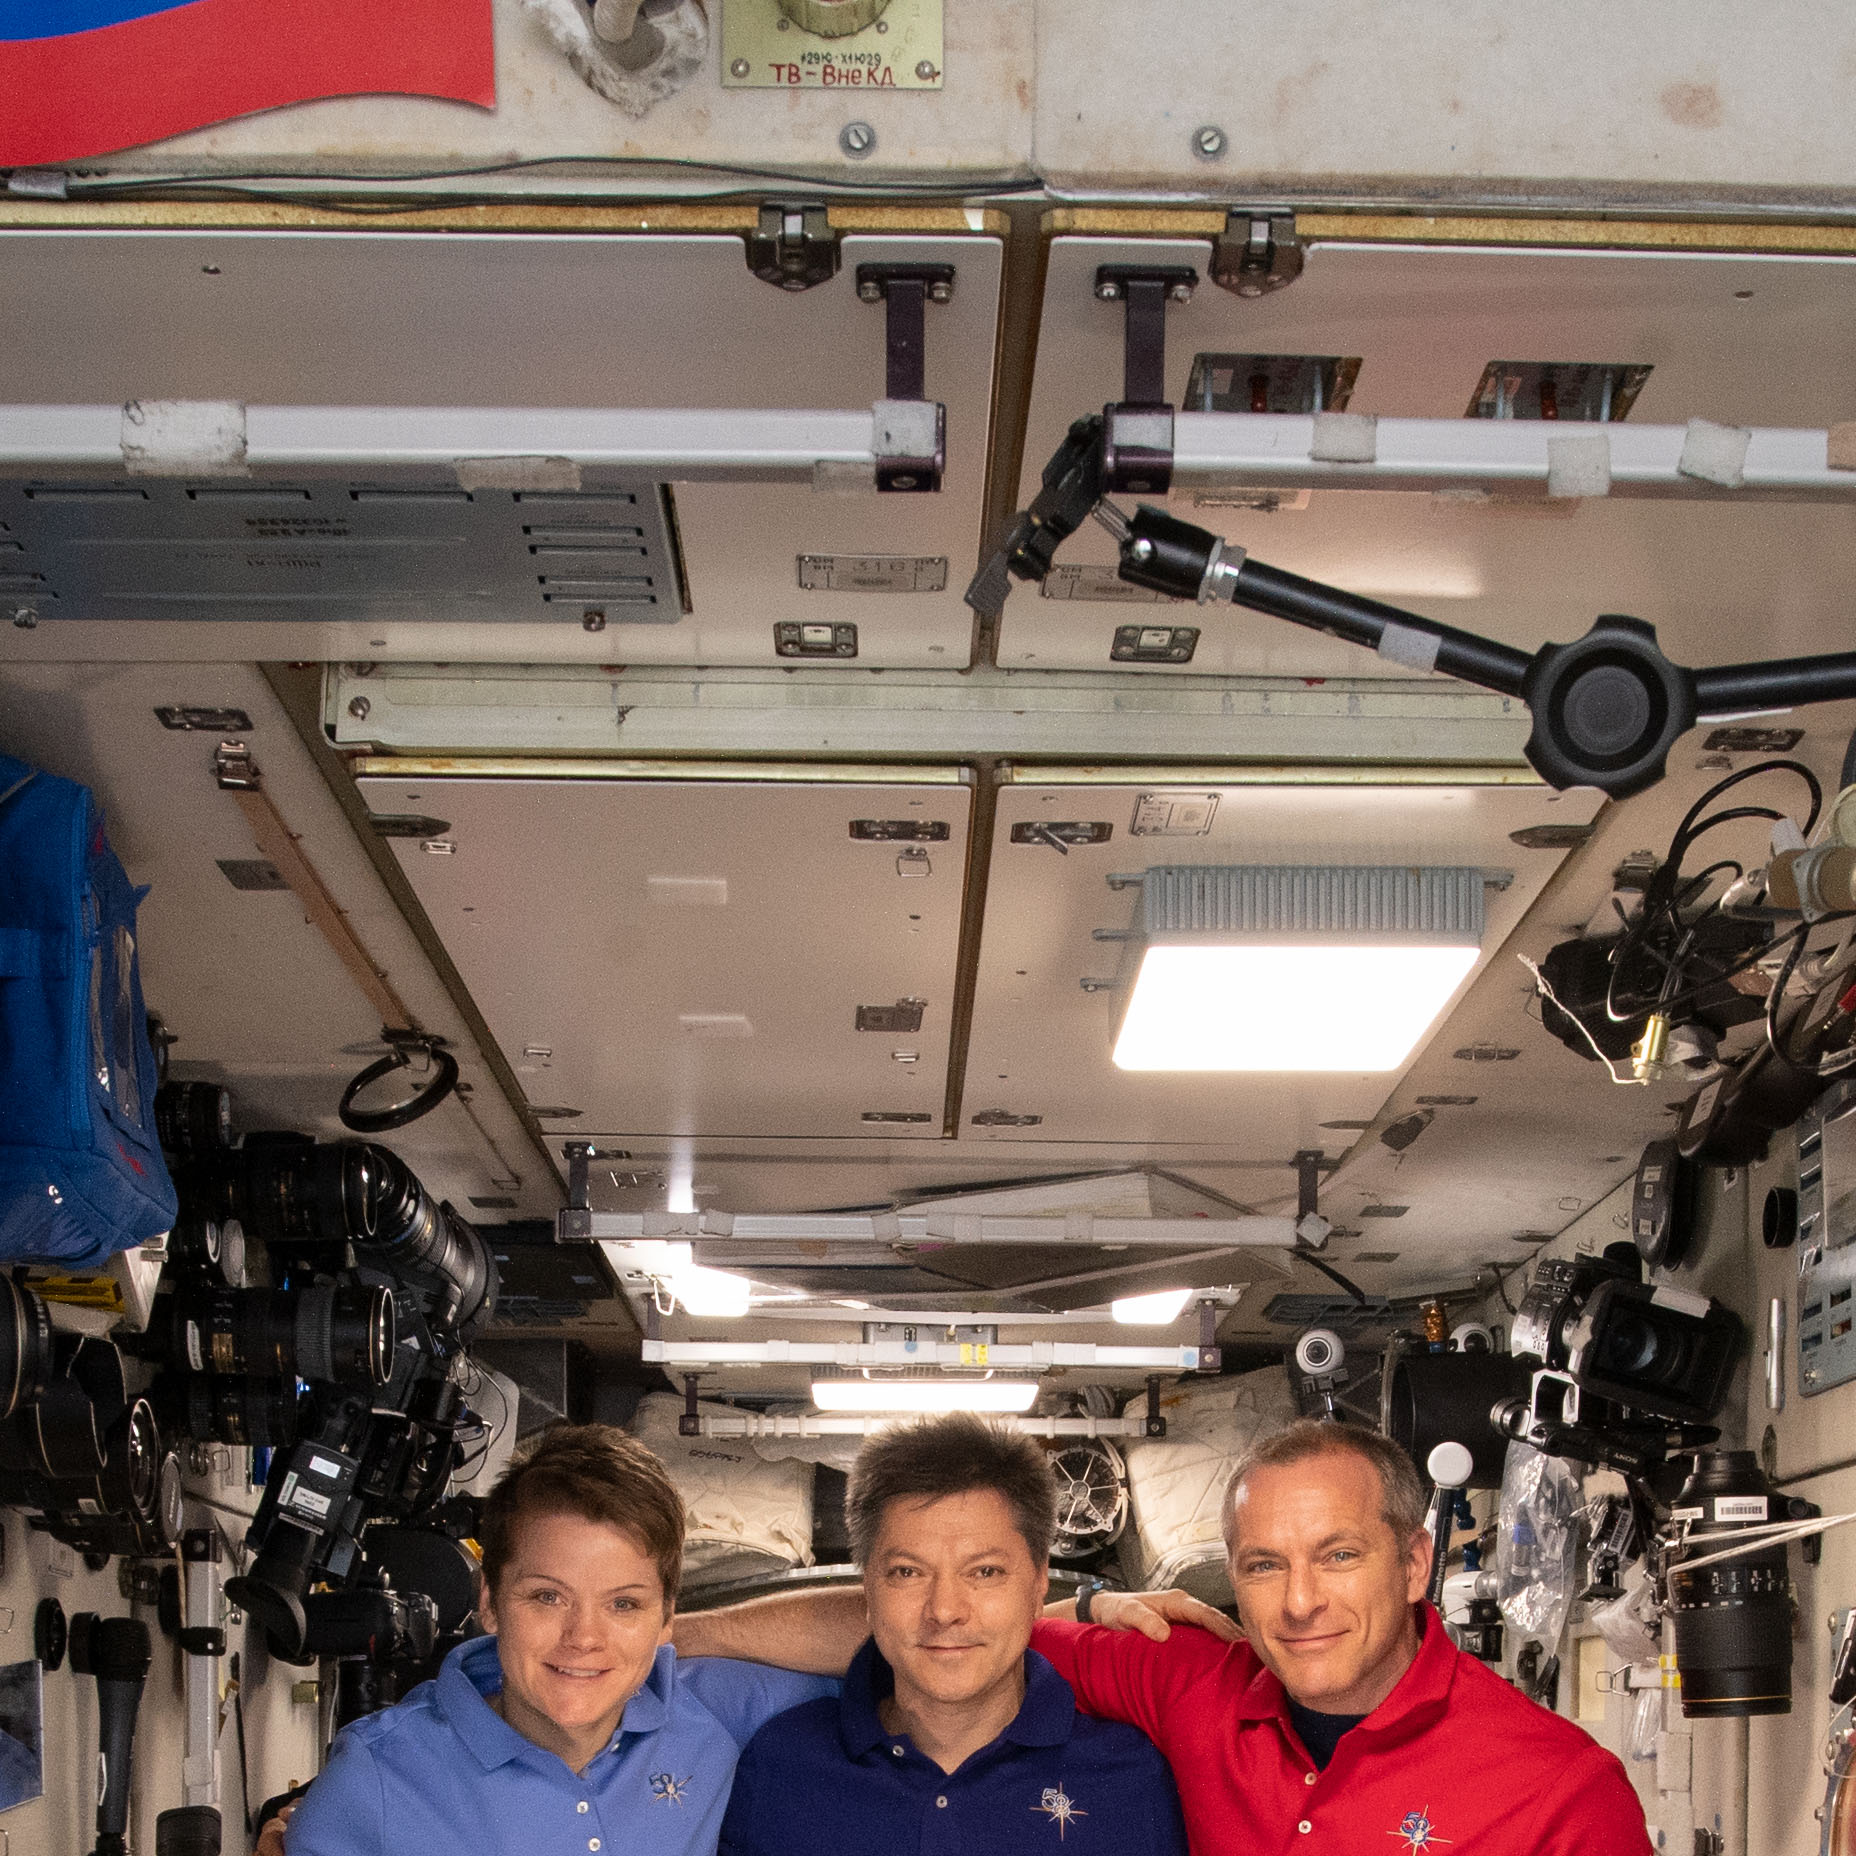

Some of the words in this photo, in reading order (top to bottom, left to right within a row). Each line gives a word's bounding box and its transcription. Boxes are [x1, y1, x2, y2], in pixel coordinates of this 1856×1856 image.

[768, 63, 801, 85] ТВ
[822, 64, 862, 86] Вне
[1615, 1453, 1638, 1464] SONY
[648, 1773, 677, 1794] 58
[1041, 1787, 1070, 1815] 58
[1399, 1812, 1429, 1844] 58
